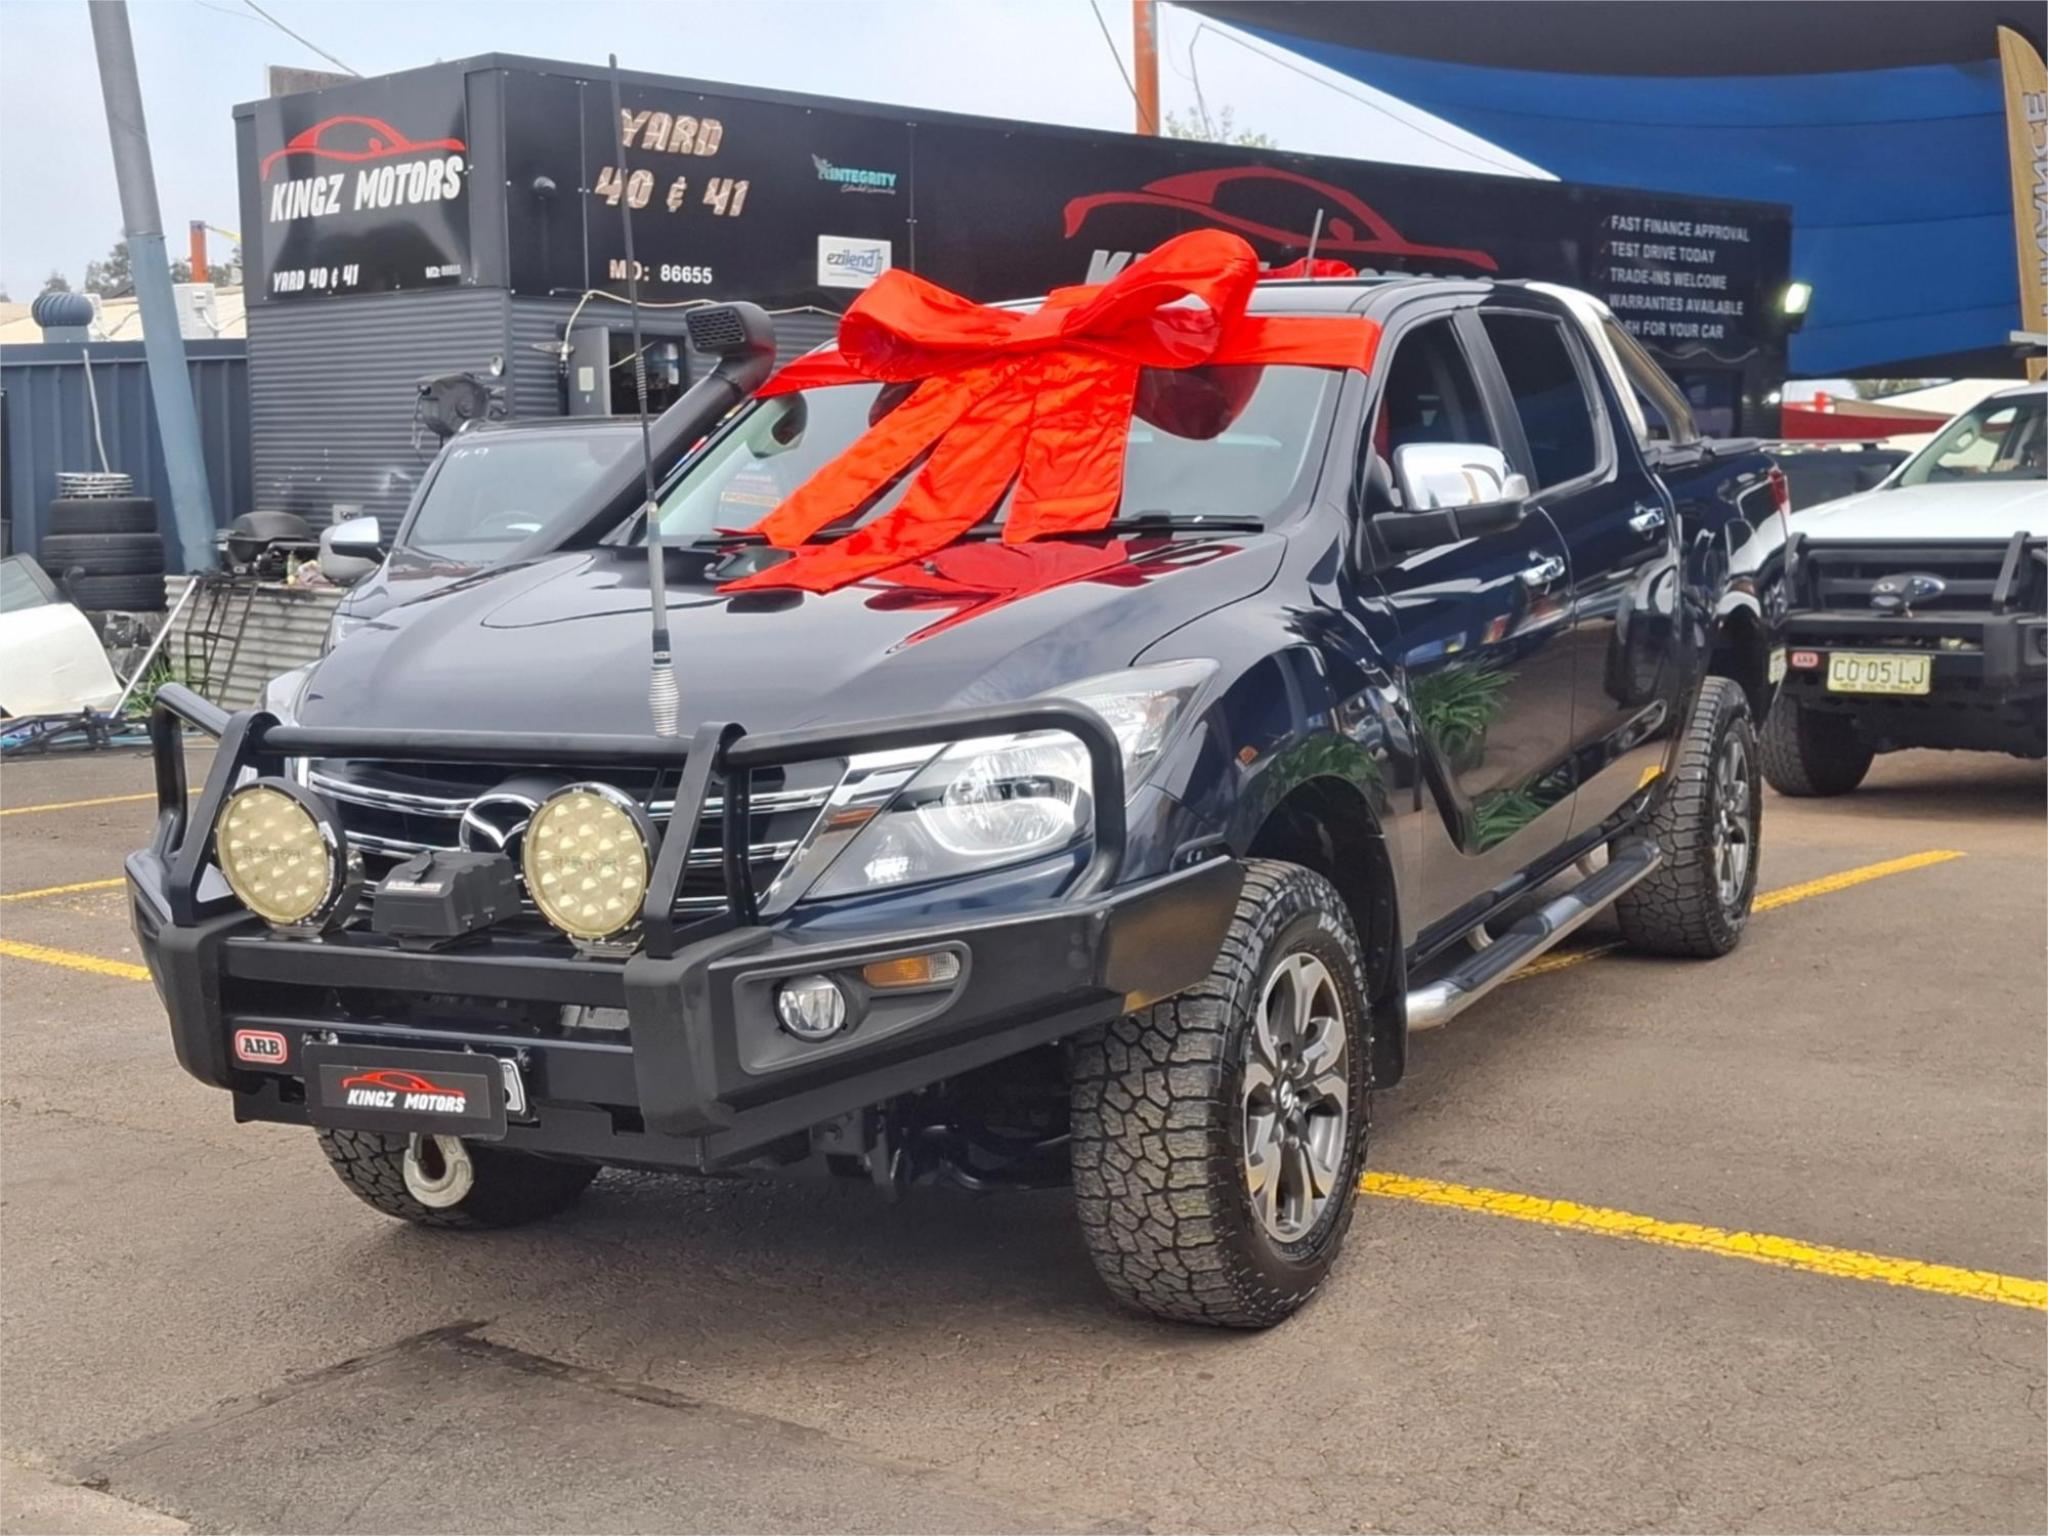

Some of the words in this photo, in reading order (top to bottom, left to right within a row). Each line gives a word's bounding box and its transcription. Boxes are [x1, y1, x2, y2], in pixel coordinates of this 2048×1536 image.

[621, 108, 723, 156] YARD
[270, 174, 345, 223] KINGZ
[354, 155, 464, 211] MOTORS
[595, 166, 654, 209] 40
[703, 177, 750, 217] 41
[1611, 215, 1641, 231] FAST
[1643, 218, 1692, 237] FINANCE
[1693, 223, 1750, 242] APPROVAL
[1611, 241, 1641, 257] TEST
[1643, 244, 1677, 261] DRIVE
[1679, 247, 1716, 264] TODAY
[273, 269, 305, 293] YARD
[309, 267, 328, 289] 40
[343, 263, 359, 286] 41
[660, 264, 713, 284] 86655
[1610, 267, 1671, 287] TRADE-INS
[1673, 272, 1727, 290] WELCOME
[1609, 293, 1683, 313] WARRANTIES
[1685, 298, 1744, 316] AVAILABLE
[1643, 320, 1667, 336] FOR
[1669, 322, 1699, 338] YOUR
[1701, 324, 1724, 339] CAR
[1899, 662, 1924, 684] LJ
[243, 1037, 280, 1056] ARB
[347, 1089, 395, 1109] KINGZ
[404, 1093, 467, 1114] MOTORS
